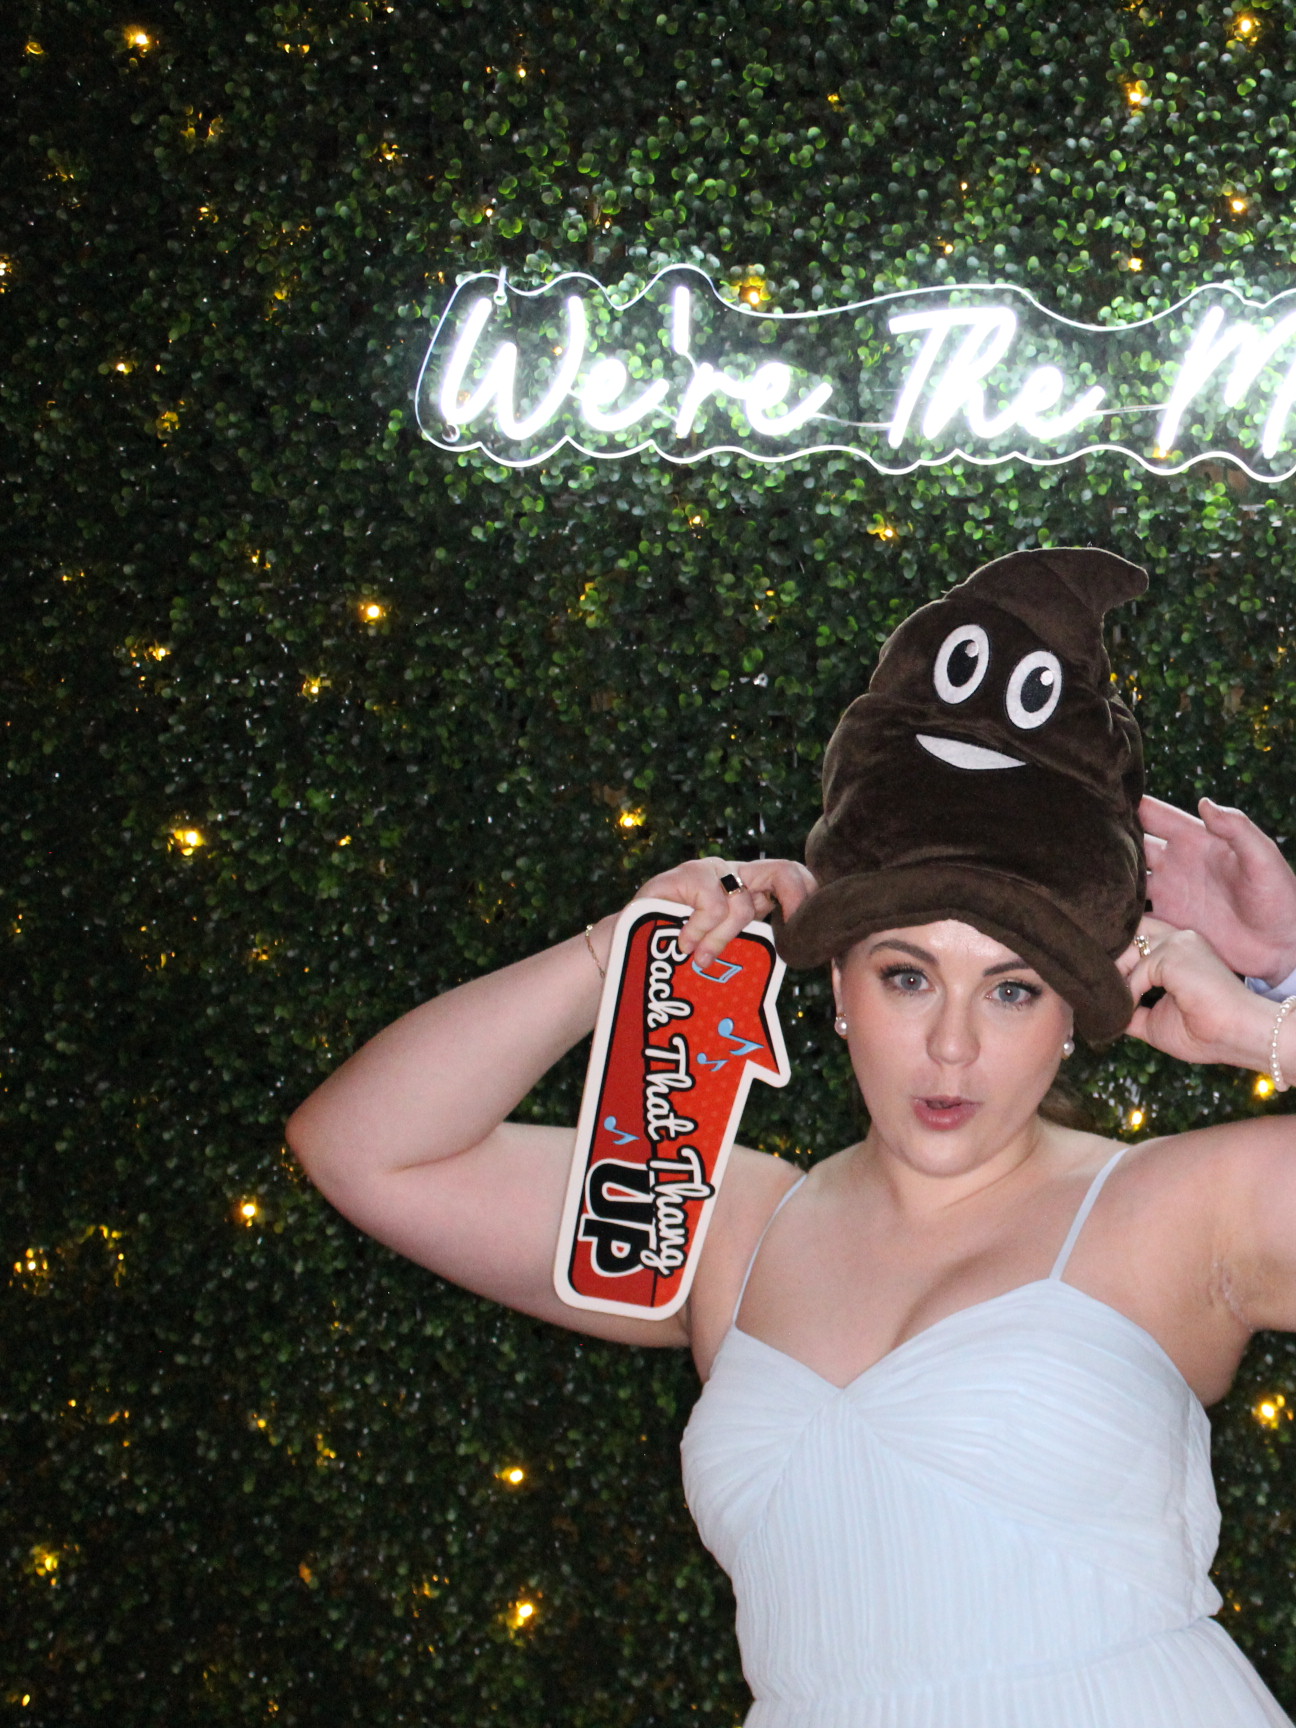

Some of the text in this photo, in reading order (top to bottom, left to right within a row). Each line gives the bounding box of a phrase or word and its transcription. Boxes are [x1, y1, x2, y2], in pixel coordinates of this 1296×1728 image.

[440, 286, 833, 441] We're
[888, 306, 1106, 448] The
[641, 926, 711, 1276] Back That Thang
[578, 1159, 658, 1277] UP
